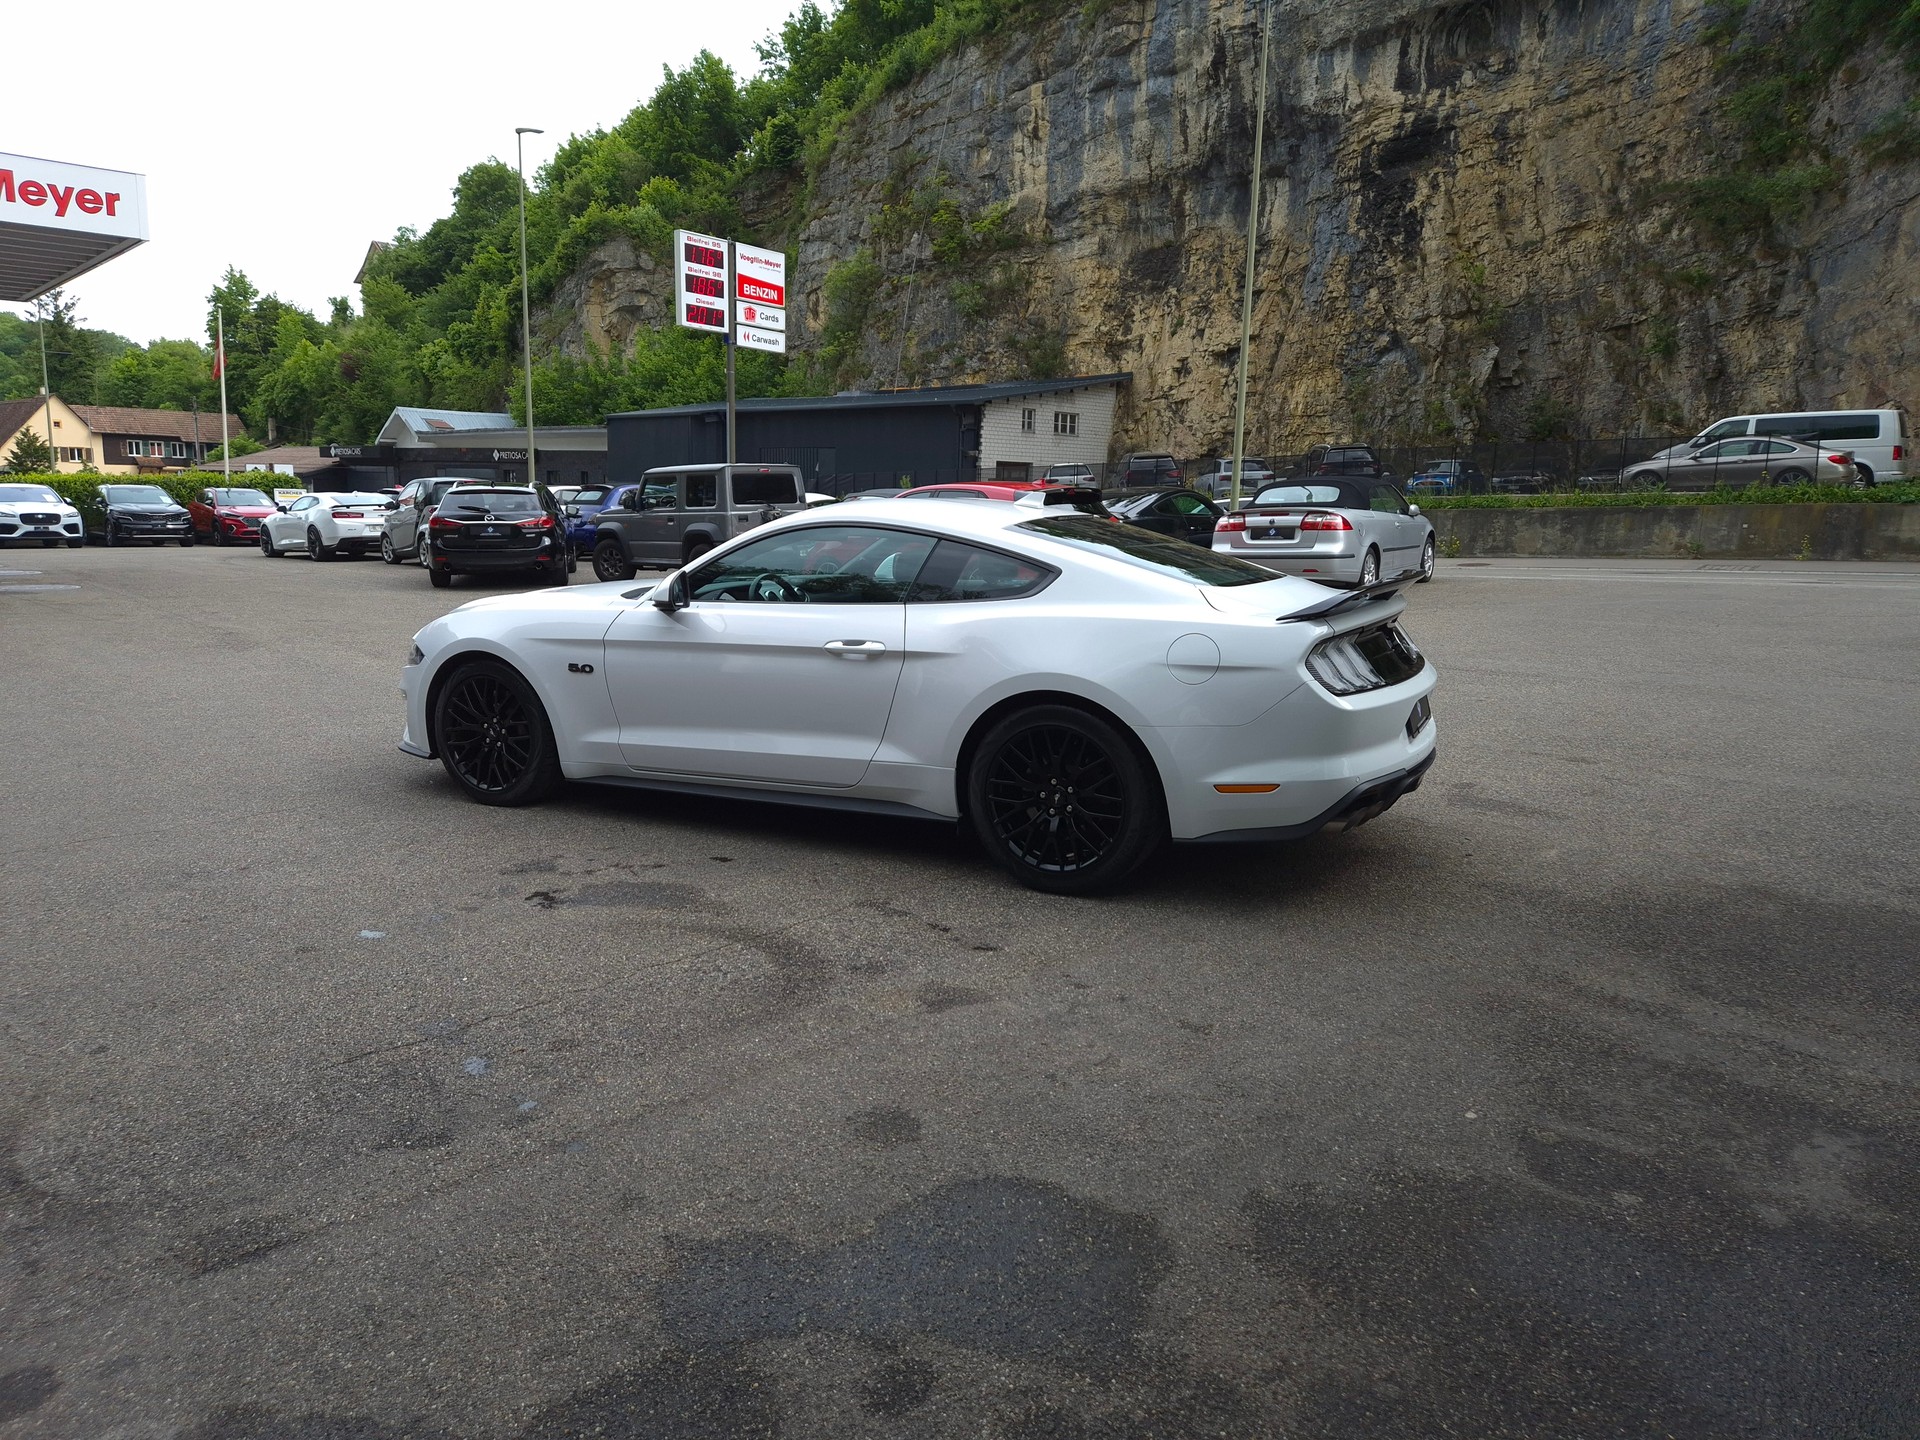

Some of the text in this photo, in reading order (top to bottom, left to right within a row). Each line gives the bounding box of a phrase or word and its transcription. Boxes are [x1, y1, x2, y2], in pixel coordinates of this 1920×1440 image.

[743, 283, 778, 301] BENZIN
[695, 297, 715, 306] Diesel
[759, 311, 779, 323] Cards
[751, 333, 780, 346] Carwash
[567, 662, 594, 674] 5.0
